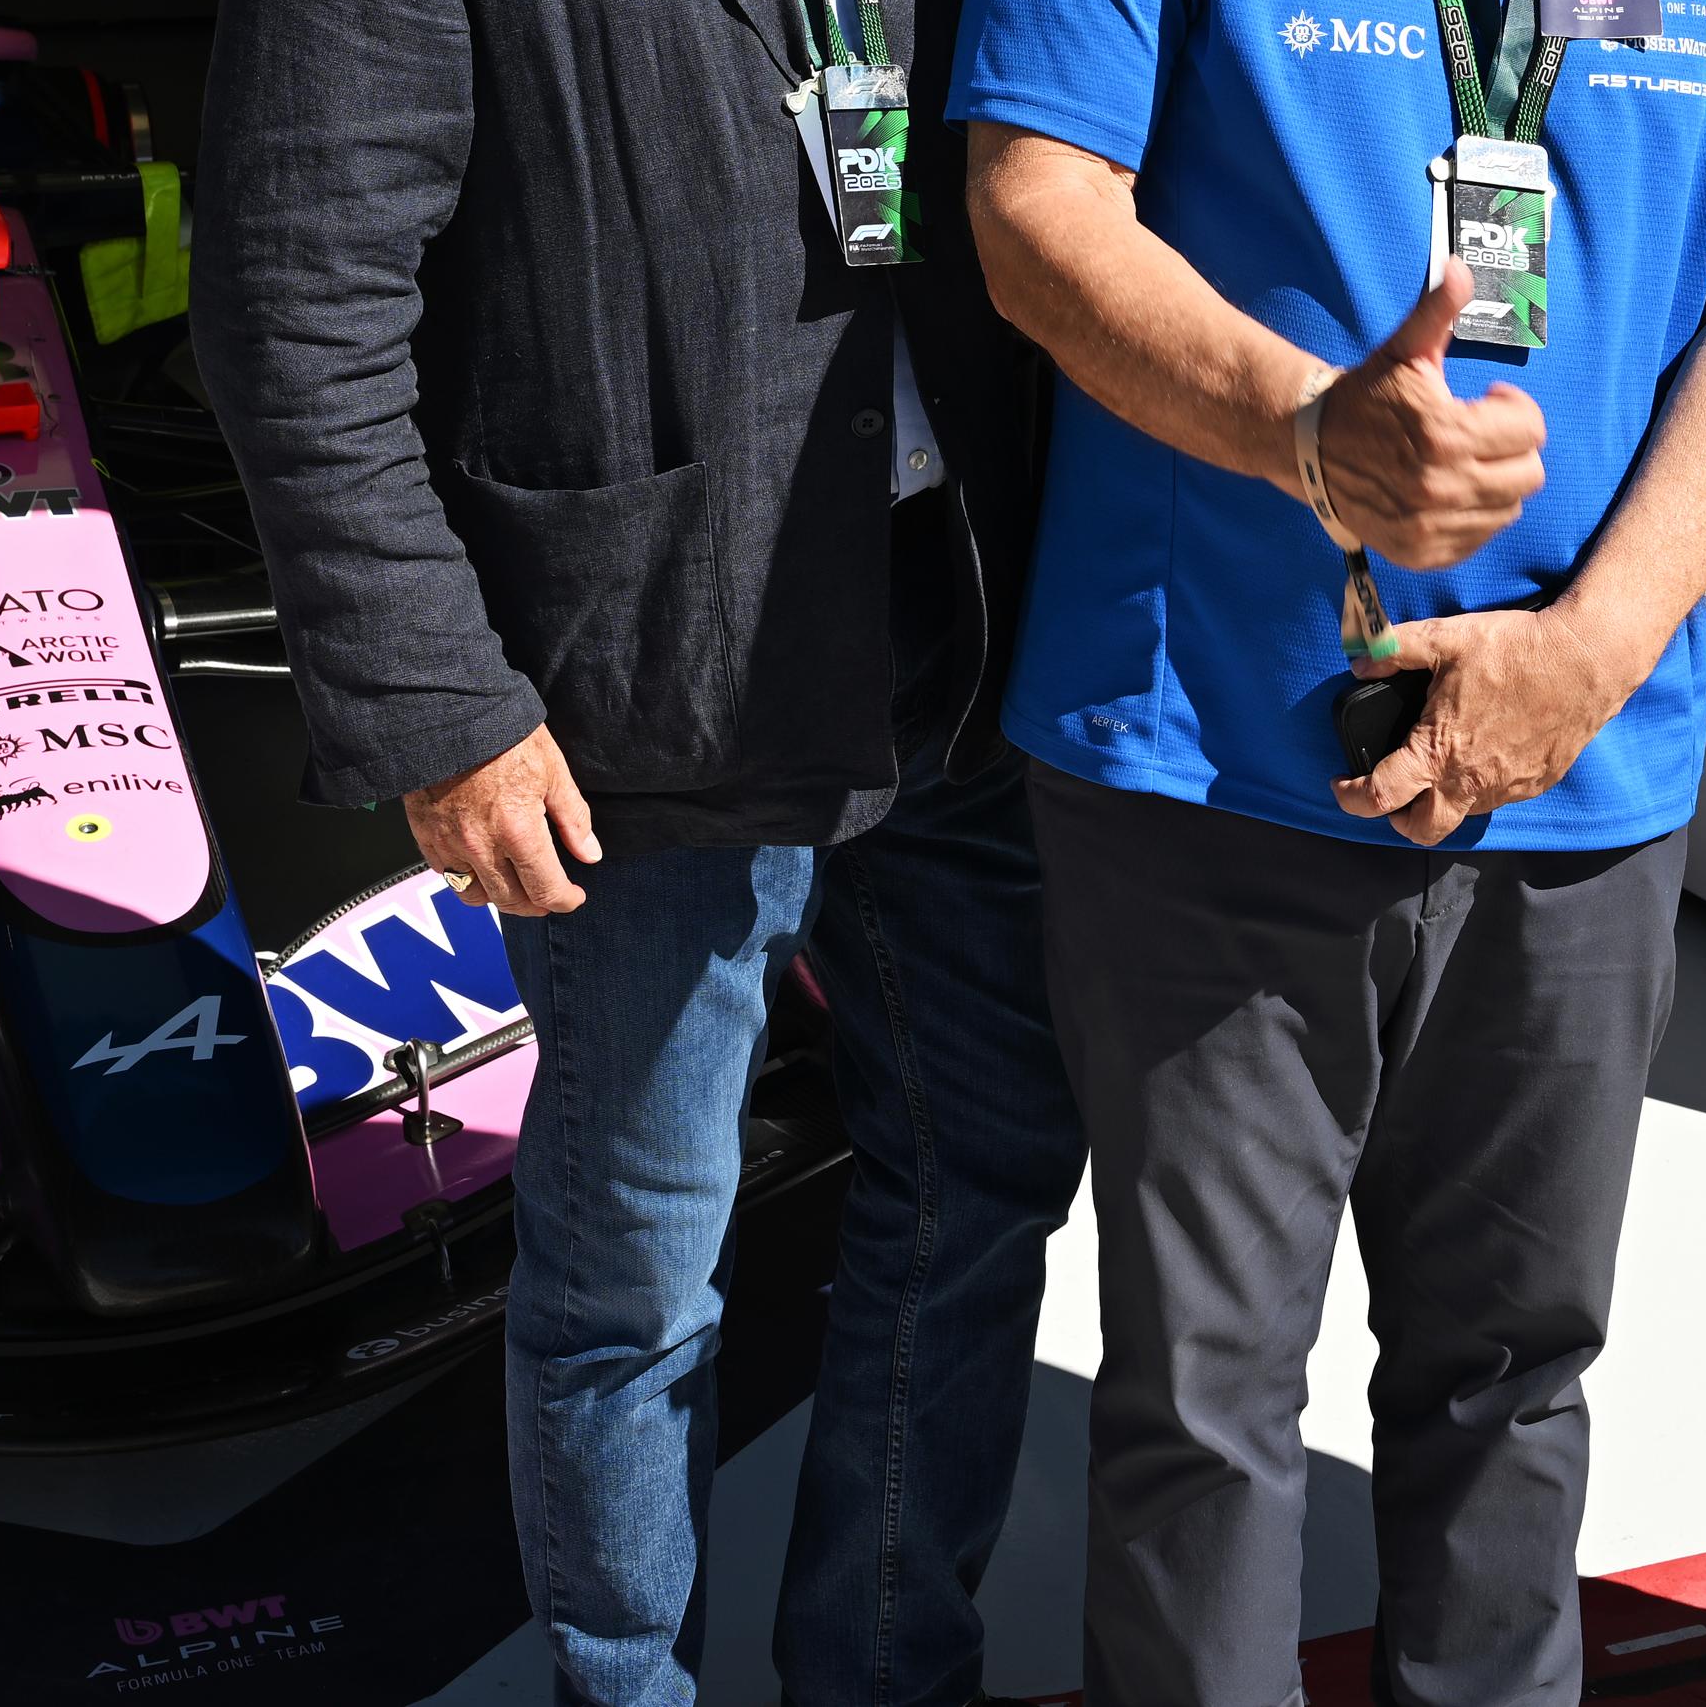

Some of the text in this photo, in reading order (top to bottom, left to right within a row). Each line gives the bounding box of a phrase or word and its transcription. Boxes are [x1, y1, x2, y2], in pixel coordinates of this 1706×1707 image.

[1667, 2, 1686, 15] ONE
[1330, 18, 1426, 60] MSC
[843, 174, 902, 192] 2026
[1461, 245, 1530, 271] 2026
[21, 635, 120, 652] ARCTIC
[37, 650, 115, 664] WOLF
[34, 722, 173, 754] MSC
[63, 773, 184, 795] enilive
[169, 1594, 287, 1637] BWT
[86, 1614, 345, 1679] ALPINE
[116, 1641, 326, 1693] FORMULA ONE TEAM
